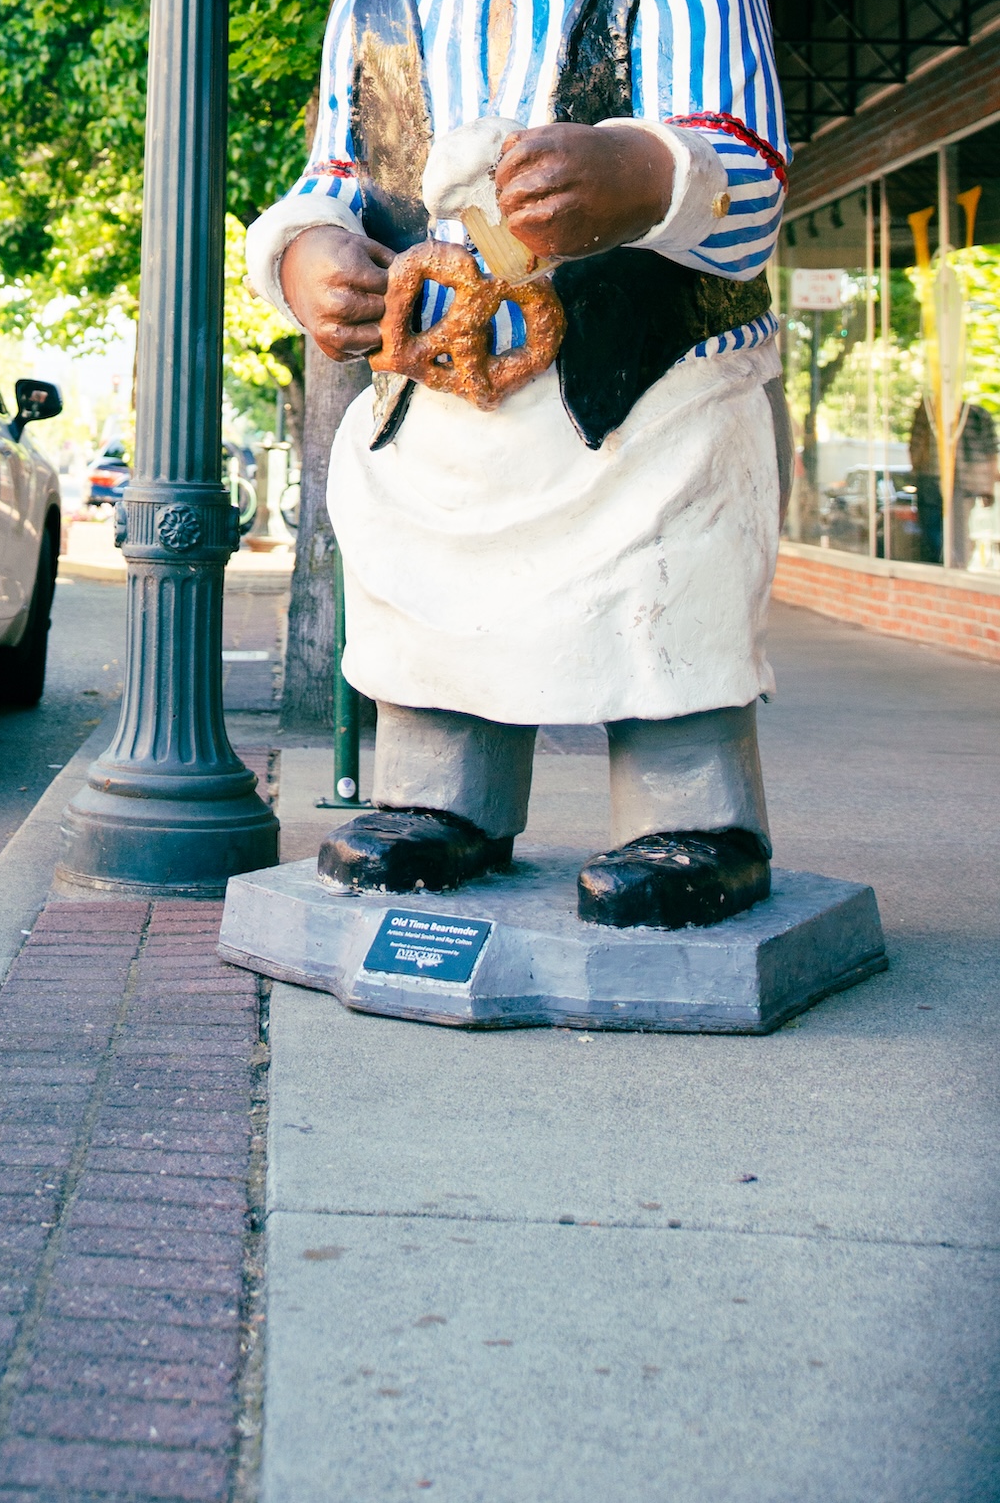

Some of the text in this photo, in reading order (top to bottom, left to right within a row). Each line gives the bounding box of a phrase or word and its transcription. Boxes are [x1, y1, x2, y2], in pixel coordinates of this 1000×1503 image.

[391, 917, 479, 936] Old Time Beartender
